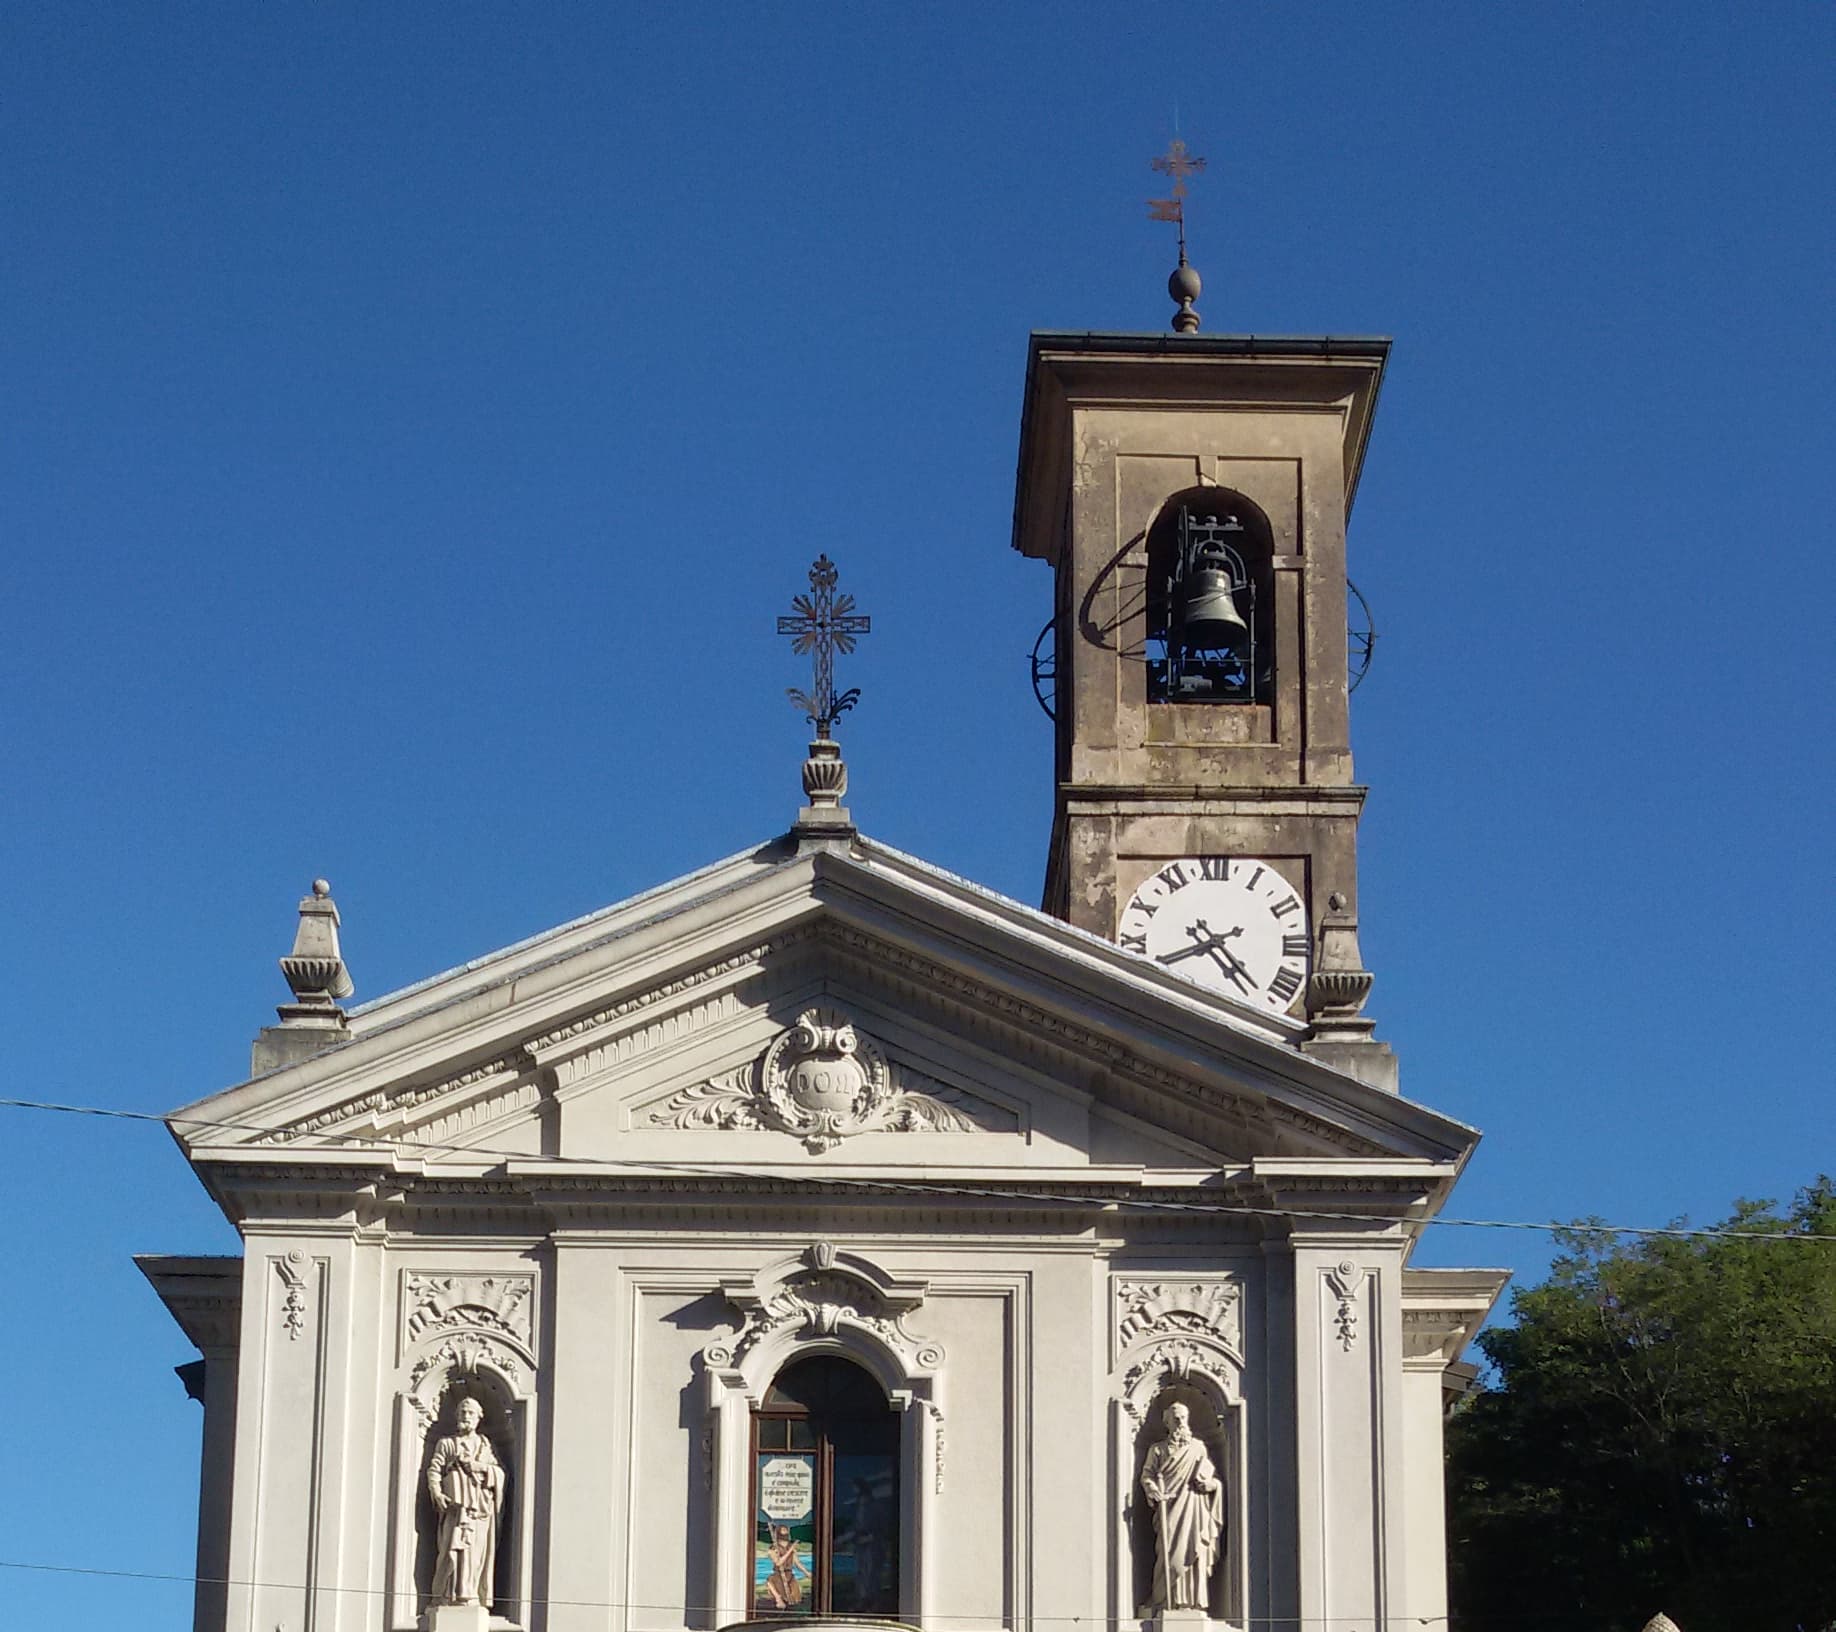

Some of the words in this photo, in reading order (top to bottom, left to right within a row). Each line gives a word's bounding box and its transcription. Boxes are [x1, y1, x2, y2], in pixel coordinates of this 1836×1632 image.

[1158, 862, 1190, 894] XI
[1199, 856, 1230, 881] XII
[1130, 896, 1160, 919] X
[1270, 894, 1300, 920] II
